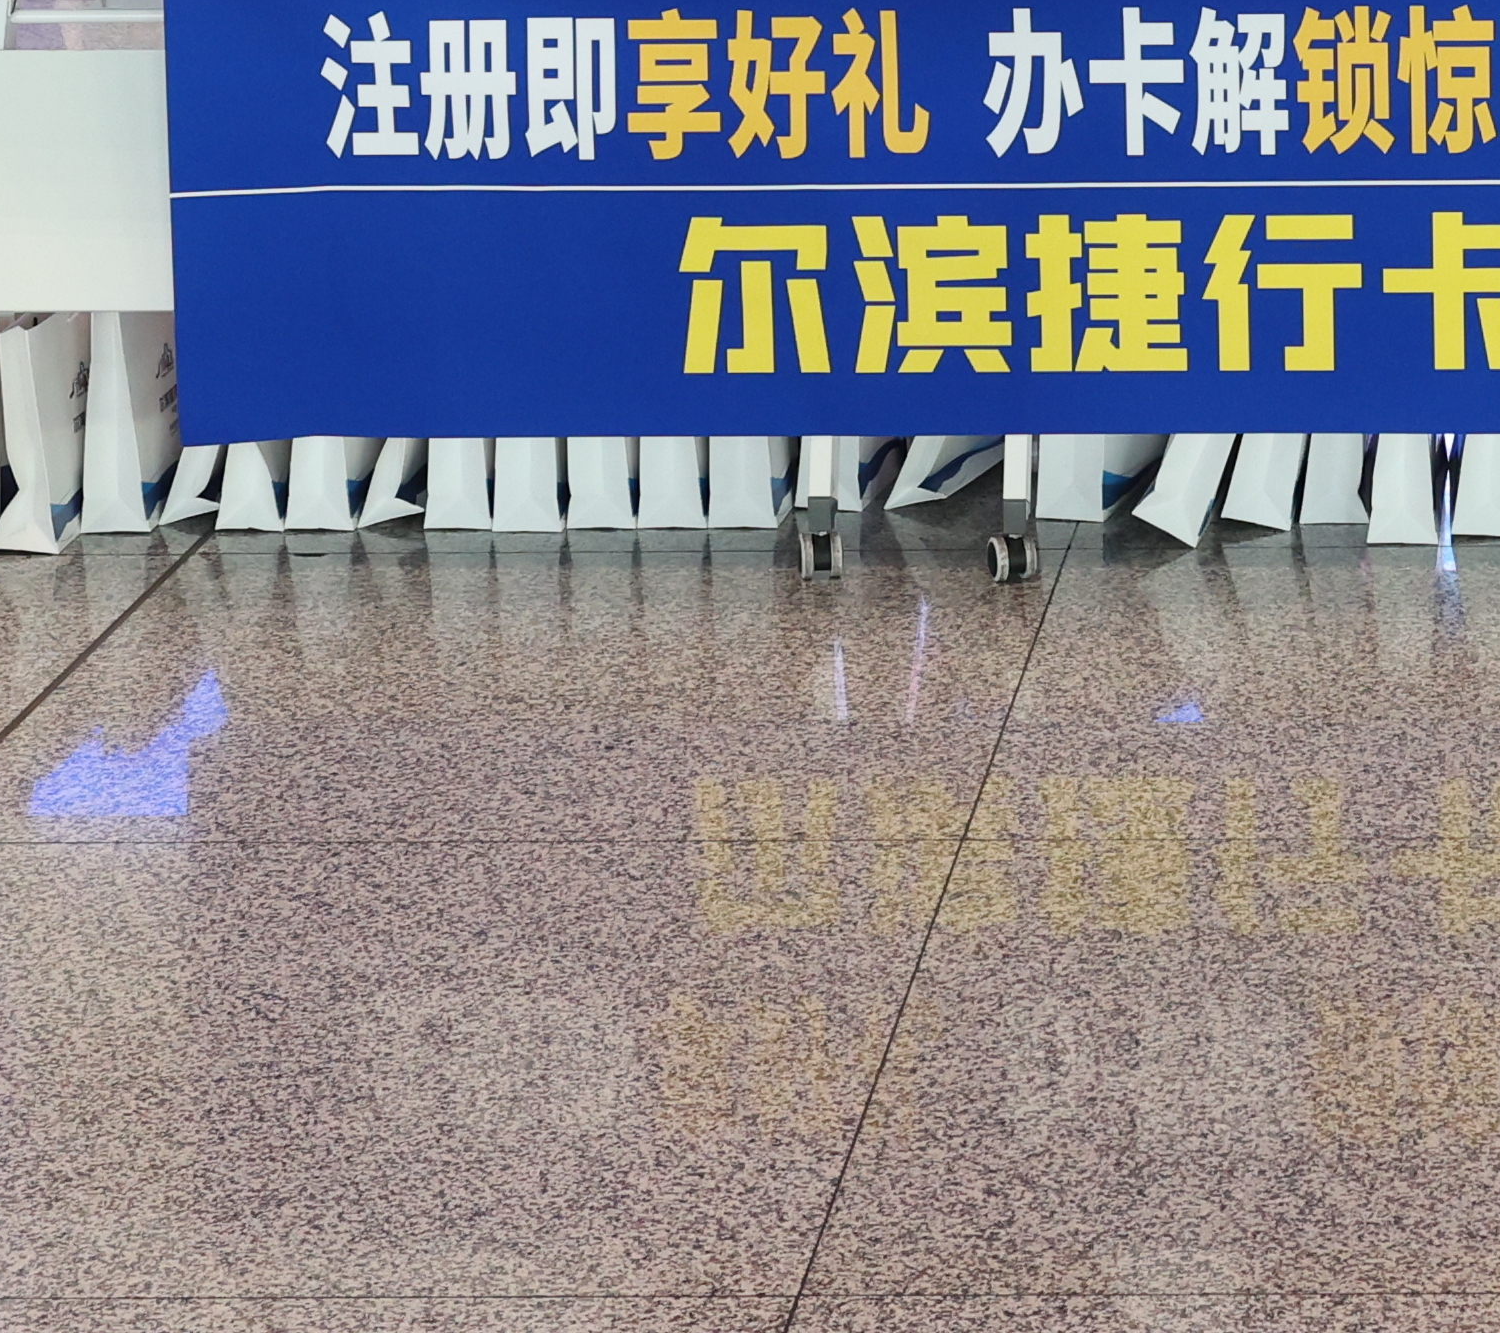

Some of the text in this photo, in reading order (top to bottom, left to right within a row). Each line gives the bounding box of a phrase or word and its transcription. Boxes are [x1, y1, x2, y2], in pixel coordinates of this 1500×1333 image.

[320, 6, 932, 161] 注册即享好礼
